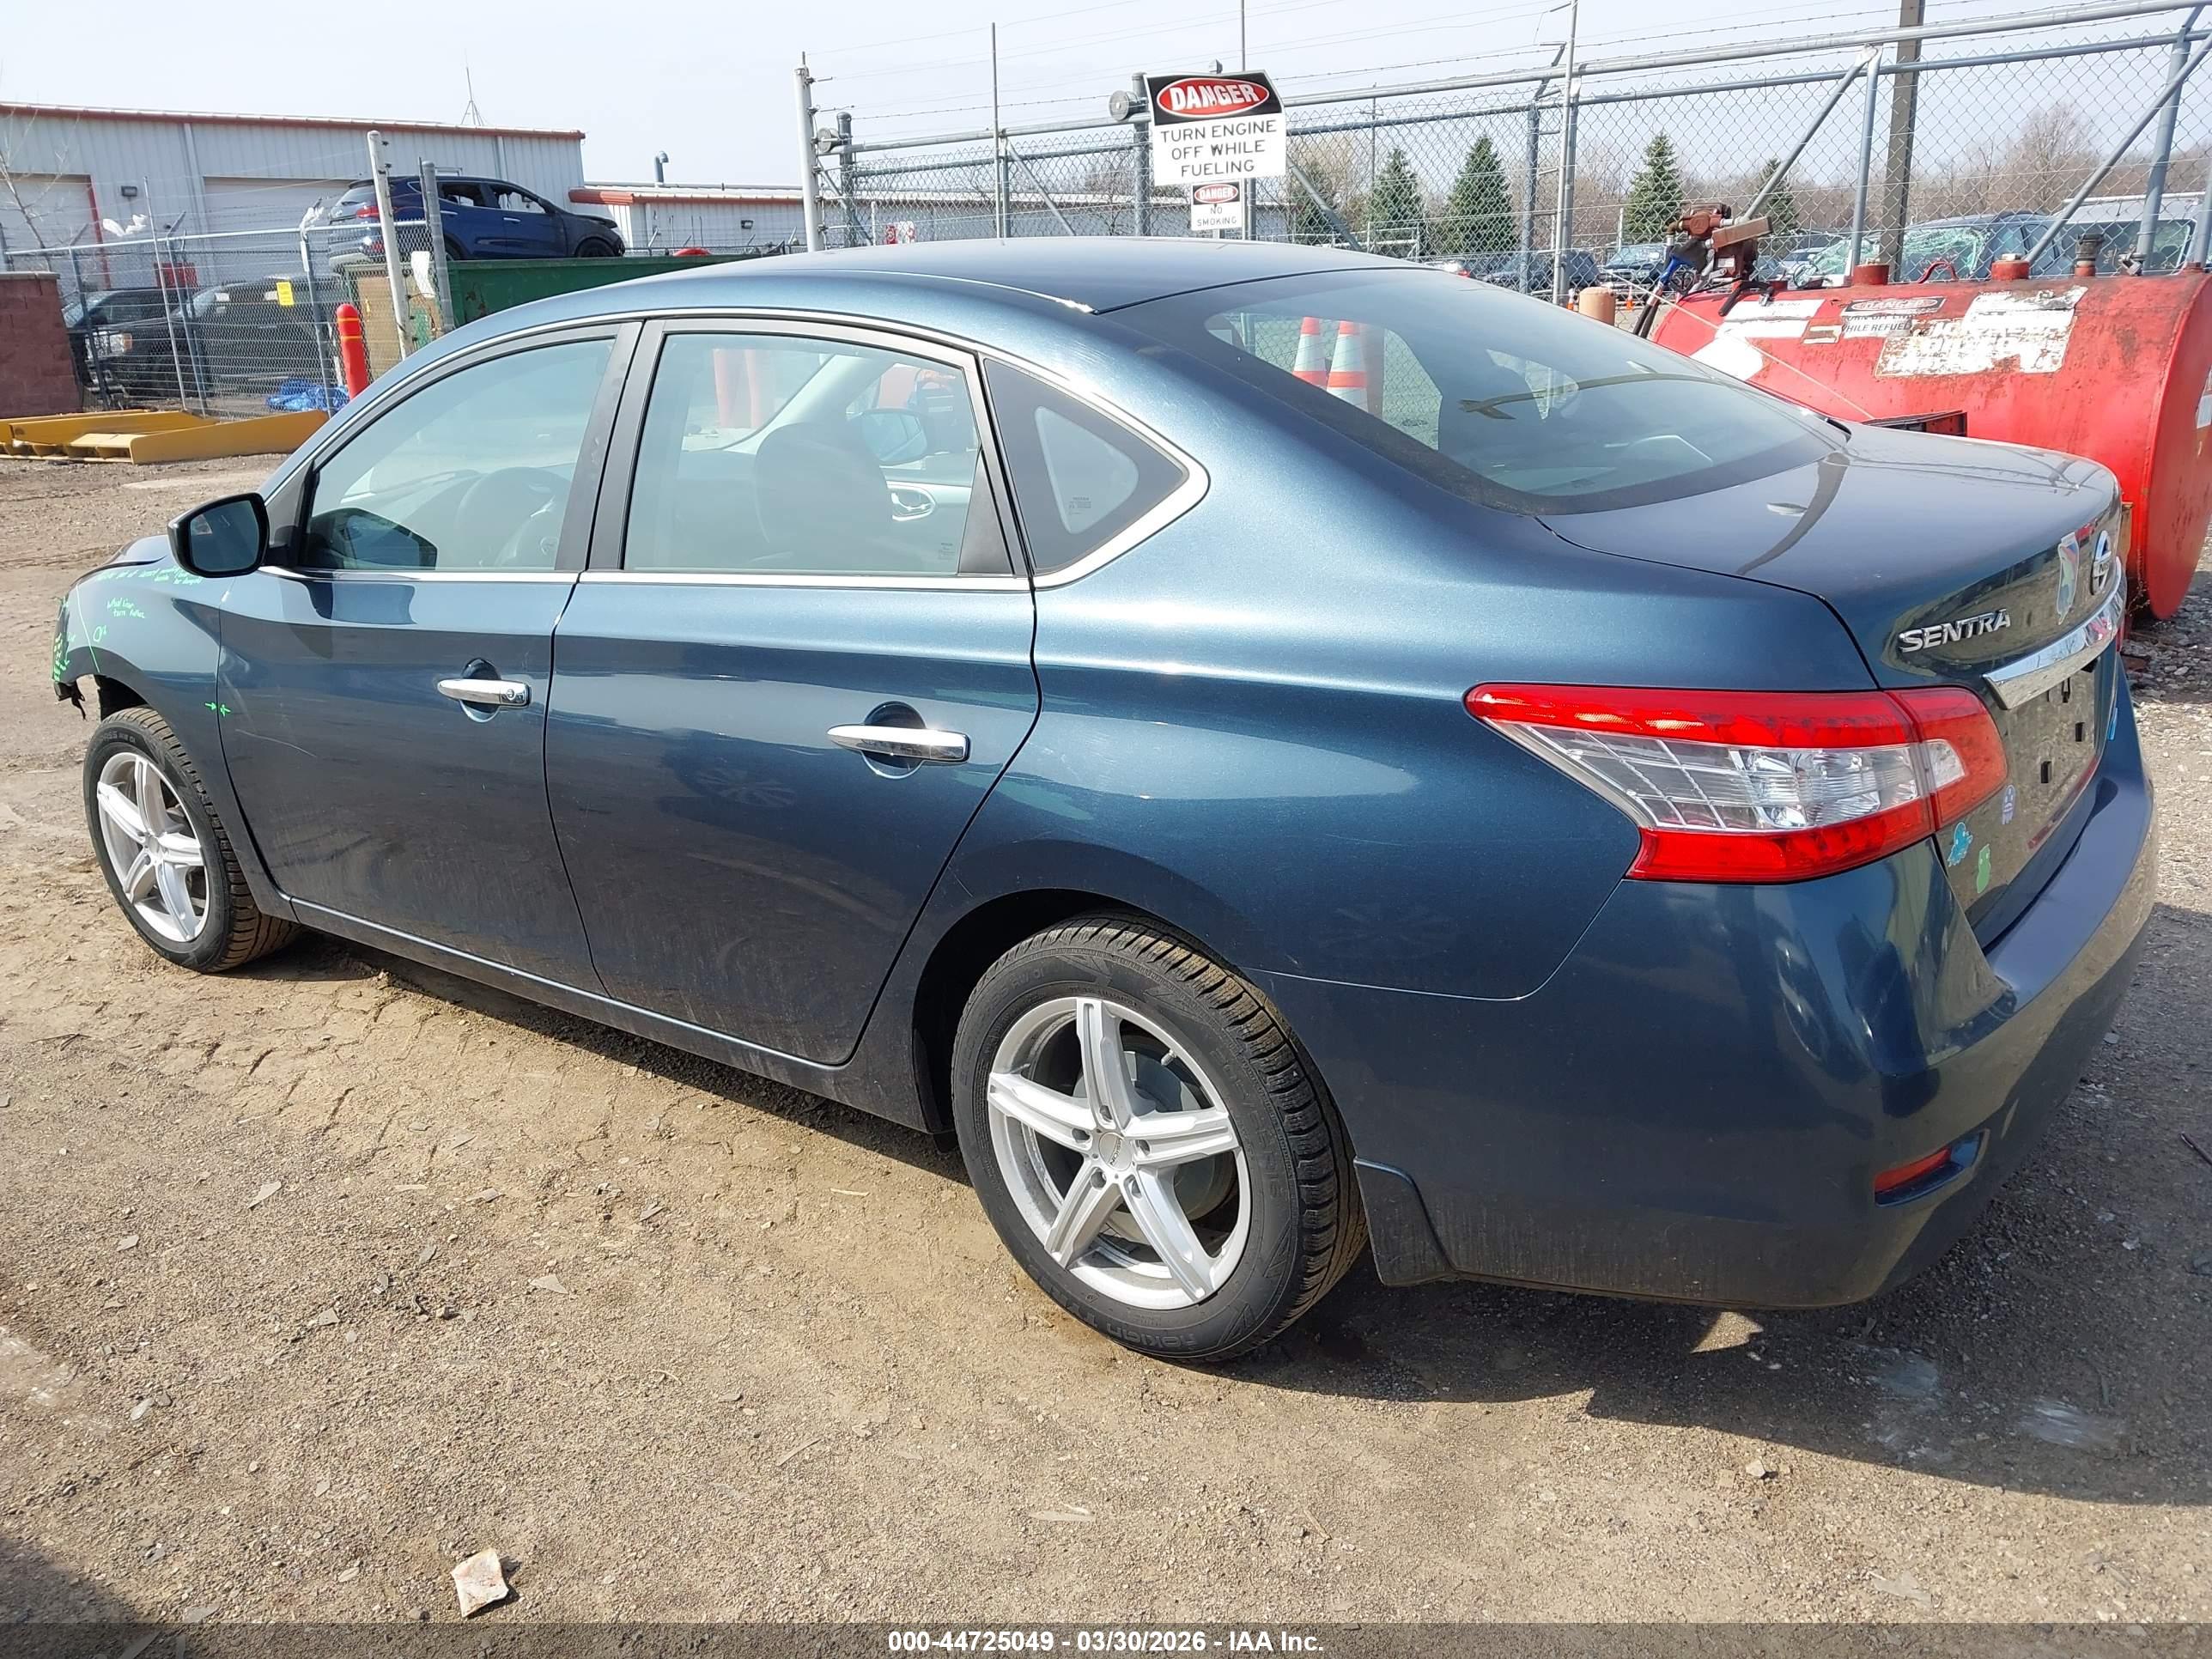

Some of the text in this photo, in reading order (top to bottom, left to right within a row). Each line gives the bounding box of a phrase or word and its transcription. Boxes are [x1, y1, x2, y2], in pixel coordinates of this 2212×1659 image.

[1170, 84, 1260, 111] DANGER
[1161, 119, 1277, 143] TURN ENGINE
[1171, 139, 1265, 160] OFF WHILE
[1181, 159, 1255, 177] FUELING
[1199, 186, 1234, 200] DANGER
[1210, 206, 1223, 215] NO
[1197, 216, 1237, 227] SMOKING
[1899, 608, 2011, 653] SENTRA
